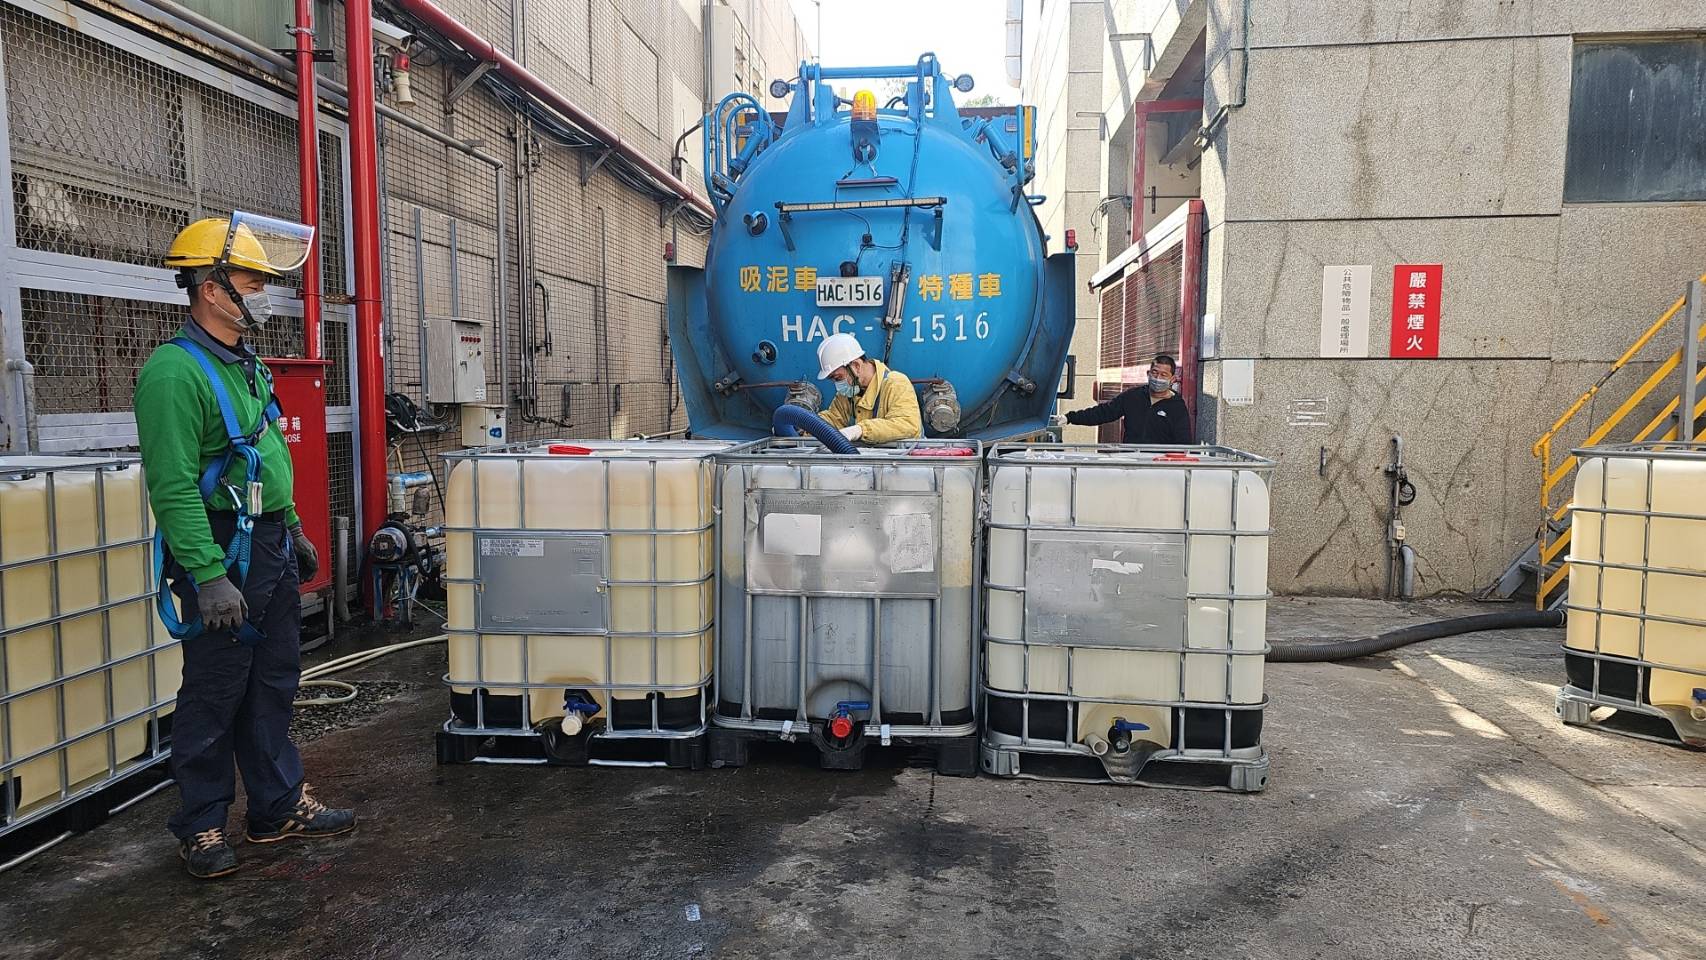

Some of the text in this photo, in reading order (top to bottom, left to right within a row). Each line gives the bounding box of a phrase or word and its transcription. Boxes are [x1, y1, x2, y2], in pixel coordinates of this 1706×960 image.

[740, 266, 817, 292] 吸泥車
[919, 272, 1002, 301] 特種車
[1406, 271, 1427, 351] 嚴禁煙火
[912, 312, 989, 342] 1516
